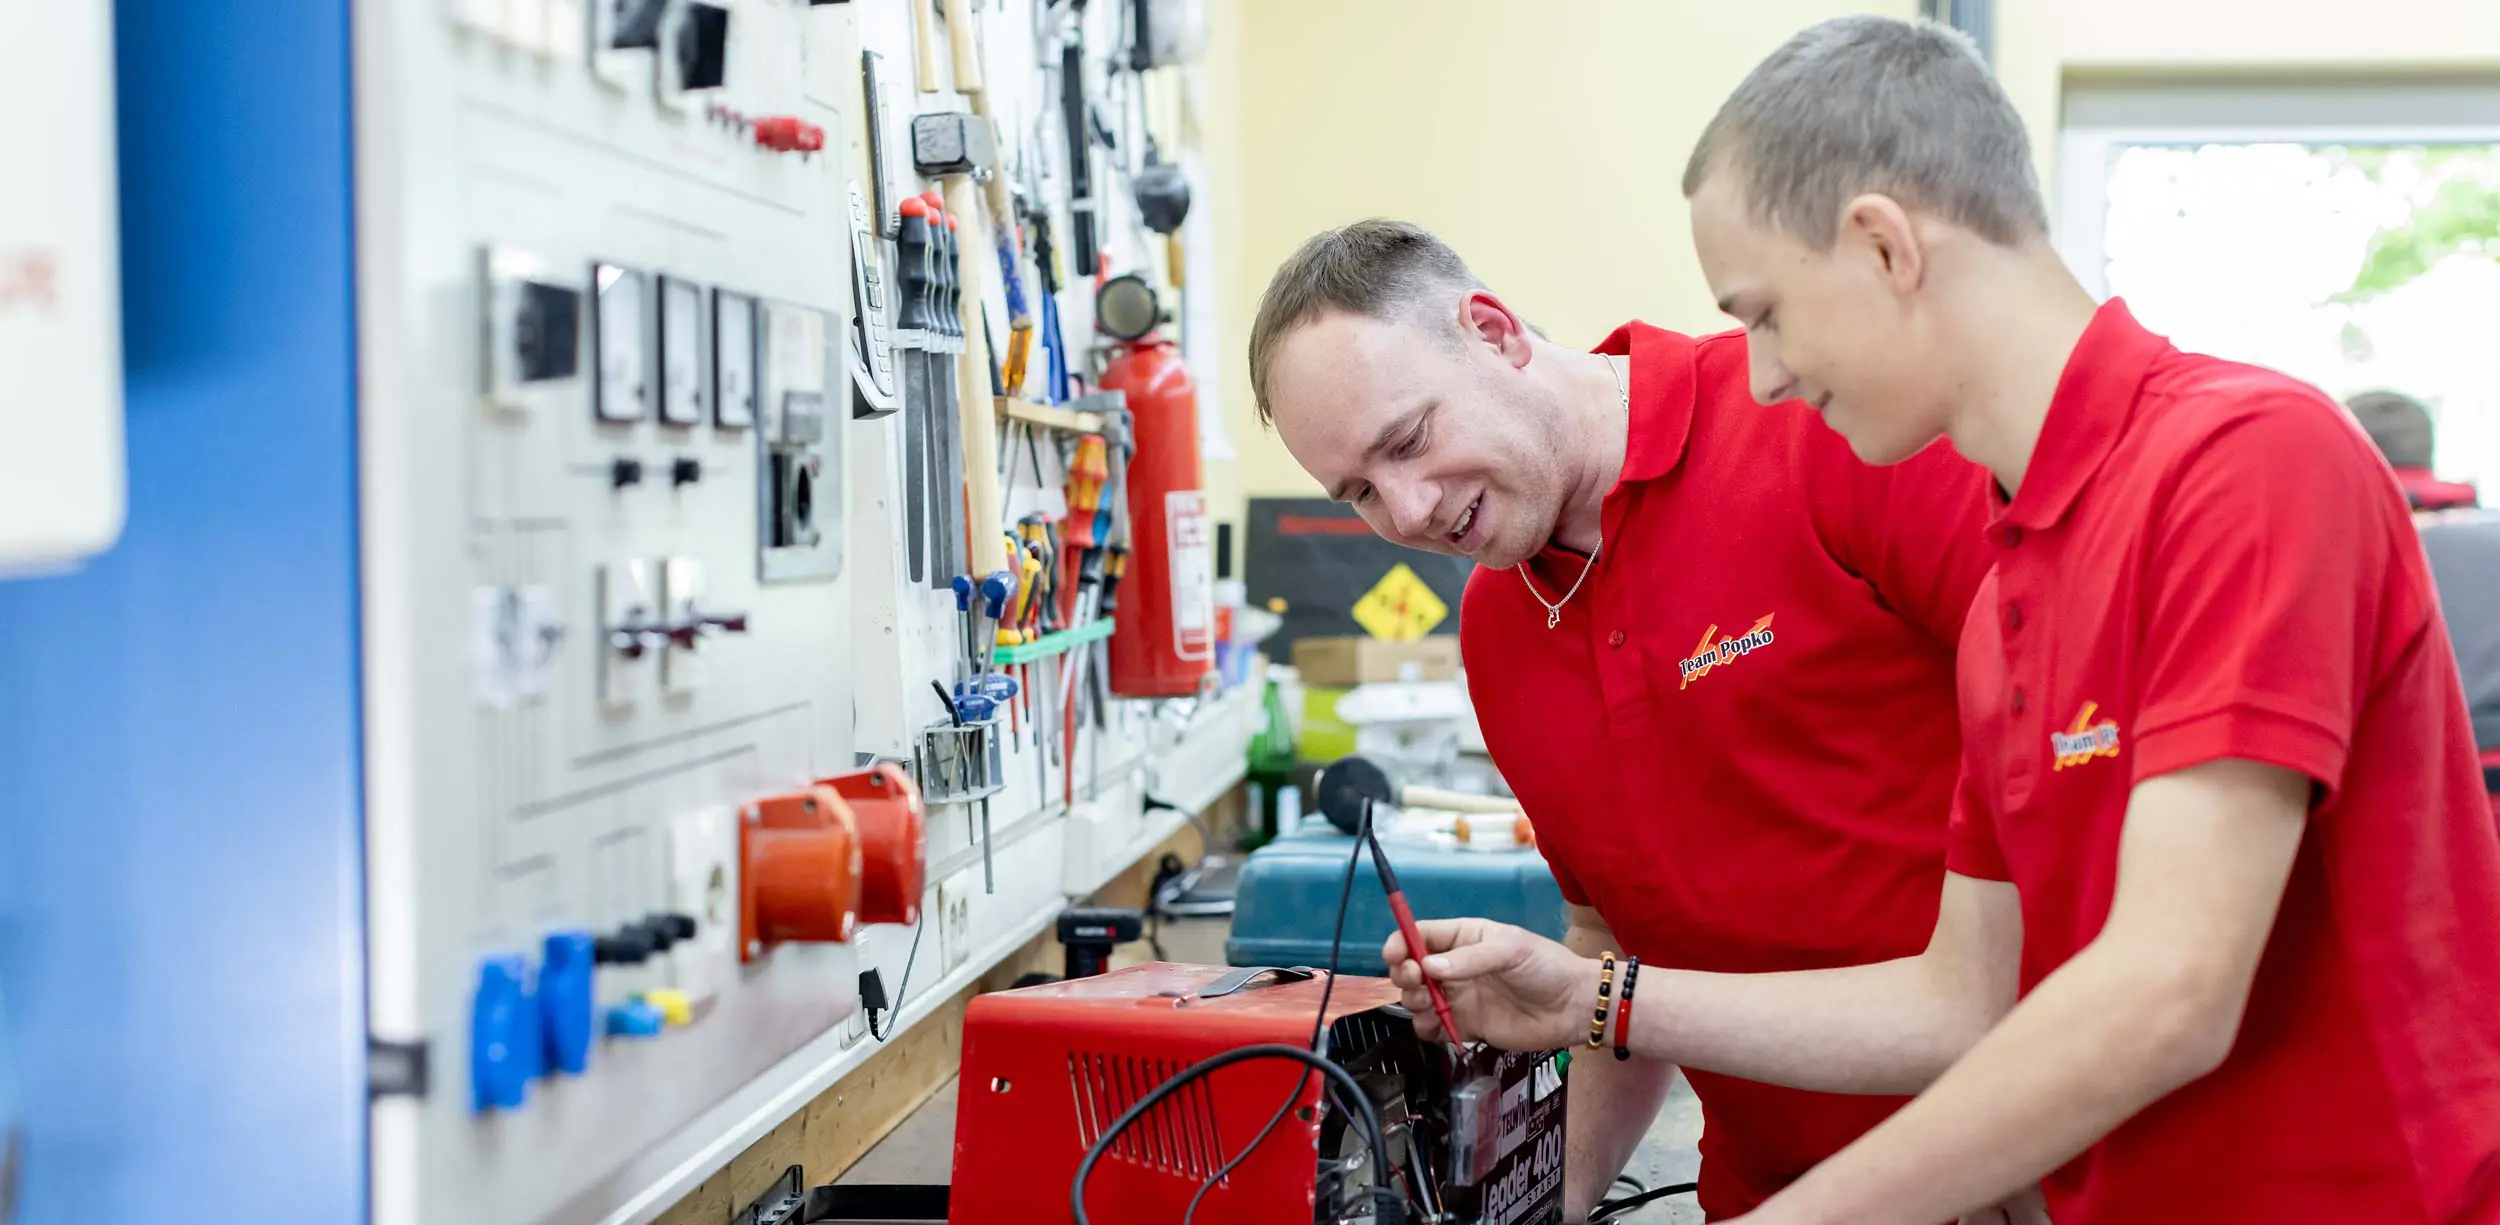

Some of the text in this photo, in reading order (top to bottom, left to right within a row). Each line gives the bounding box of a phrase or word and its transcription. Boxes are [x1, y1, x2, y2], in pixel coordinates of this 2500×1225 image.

[1679, 631, 1773, 677] Team Popko
[1481, 1154, 1531, 1218] Leader
[1533, 1124, 1561, 1181] 400
[1527, 1171, 1558, 1206] START
